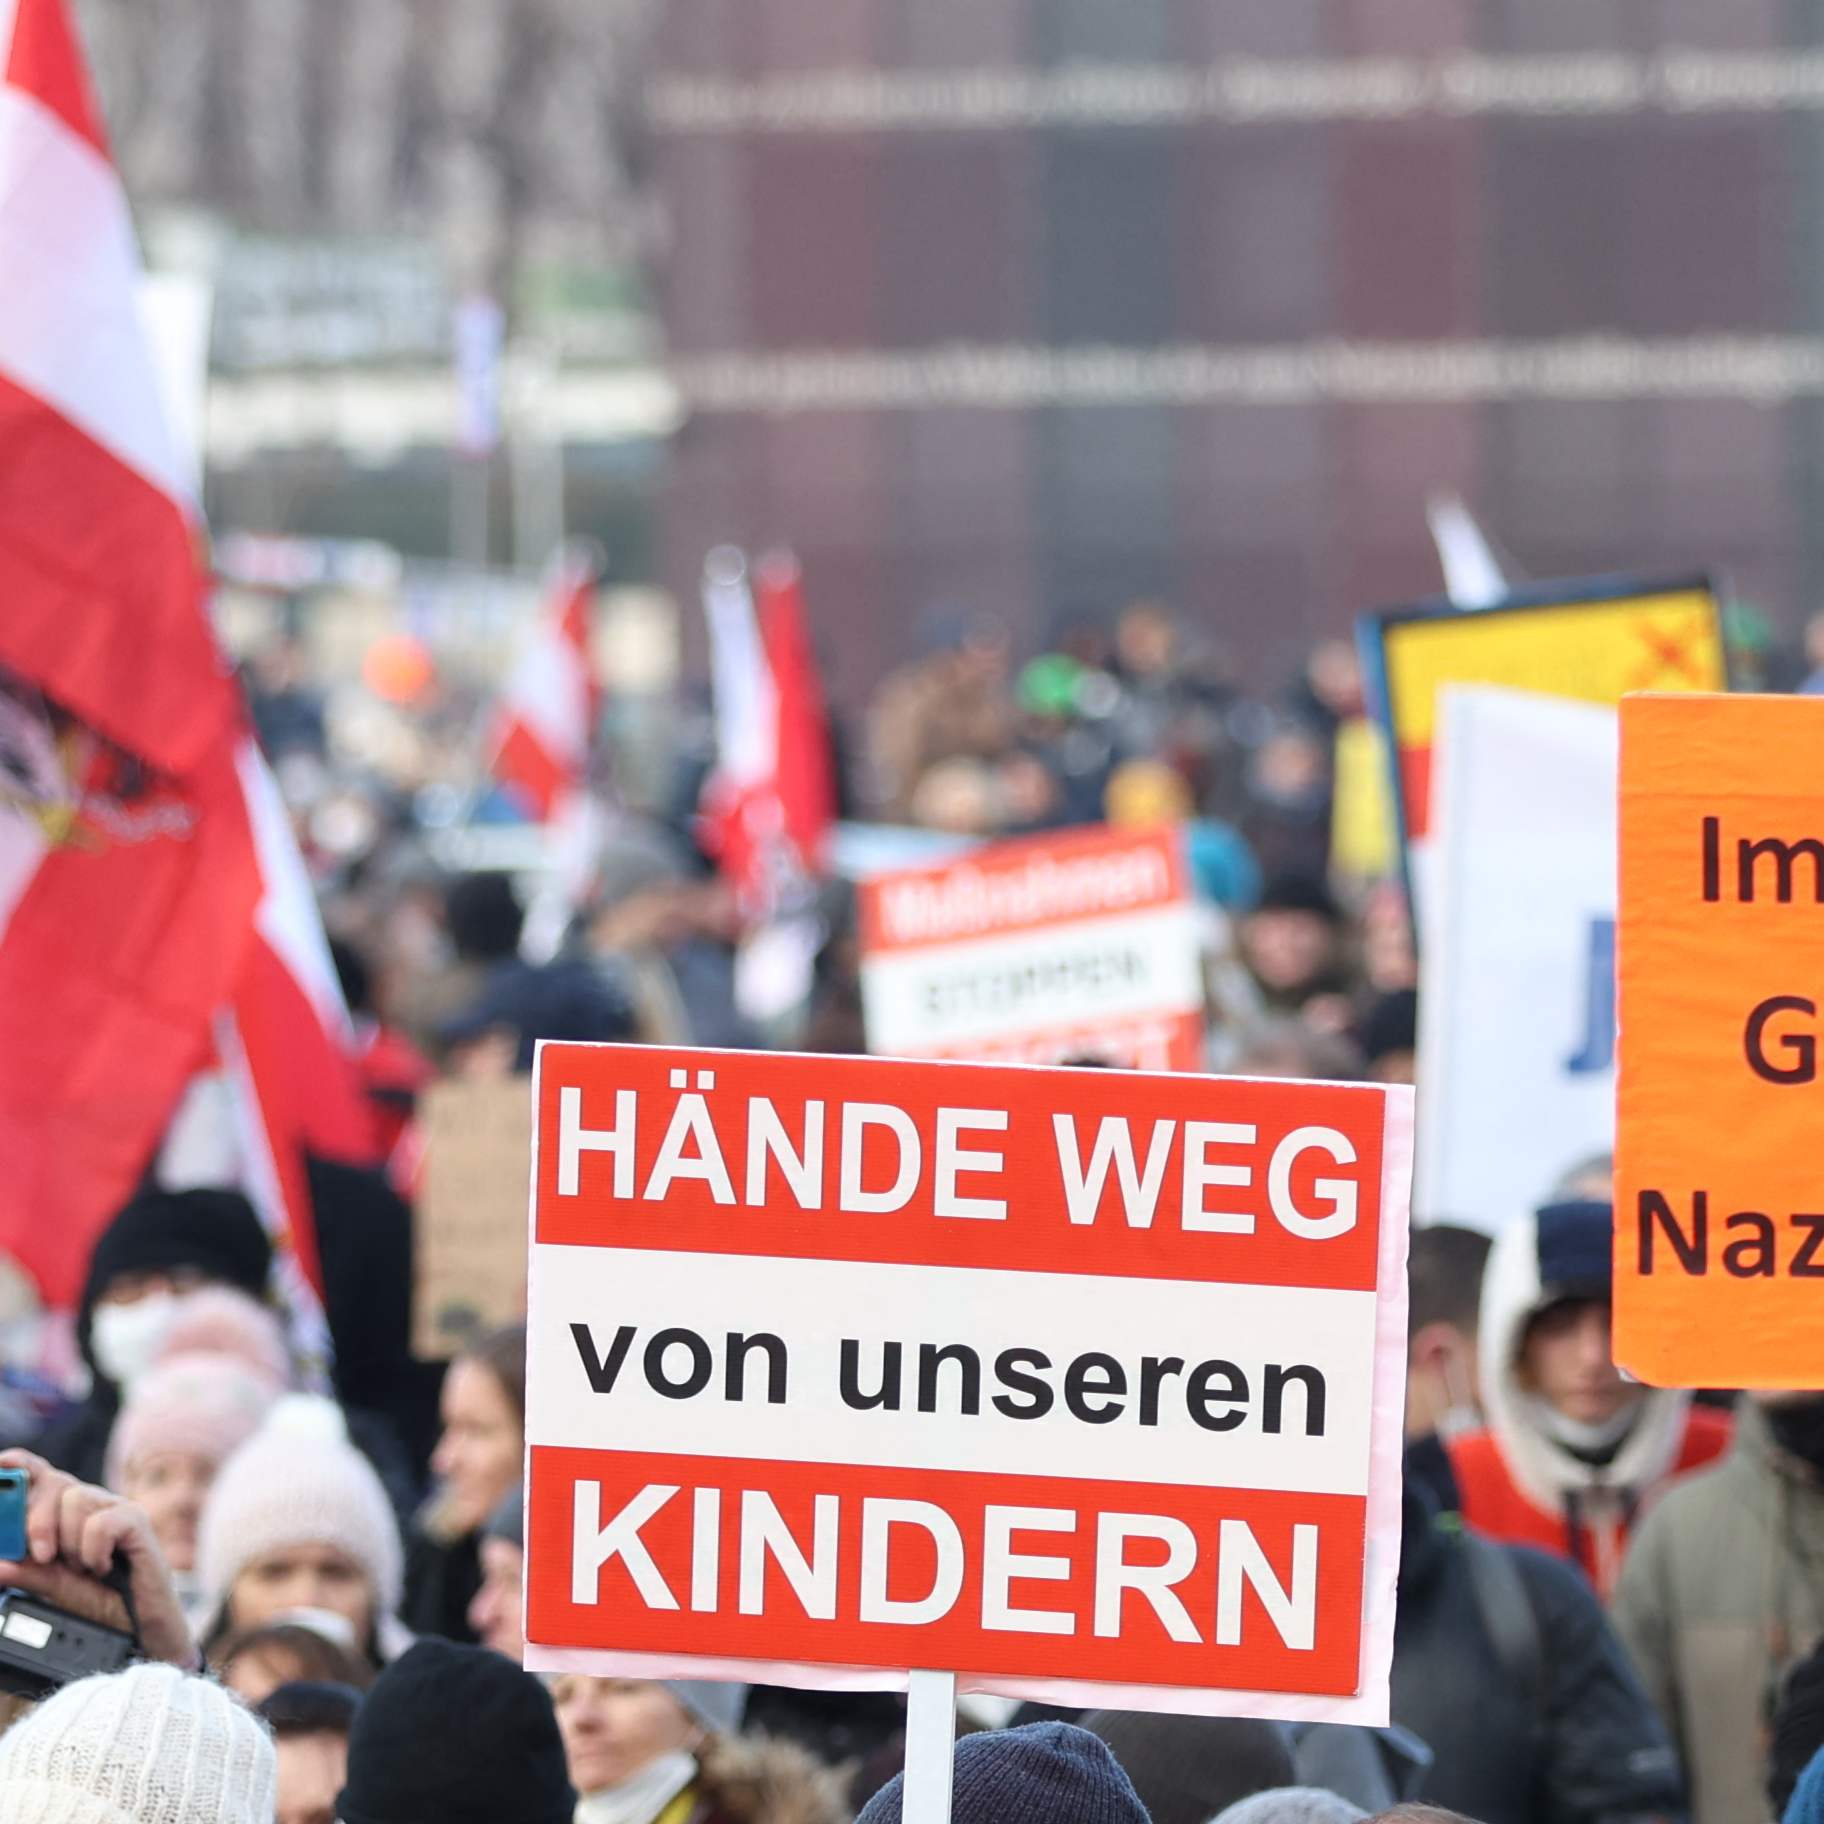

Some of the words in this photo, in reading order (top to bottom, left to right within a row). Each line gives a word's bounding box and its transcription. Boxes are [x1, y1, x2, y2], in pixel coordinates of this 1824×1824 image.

[557, 1069, 1009, 1222] HÄNDE
[1053, 1113, 1359, 1241] WEG
[570, 1322, 788, 1404] von
[840, 1338, 1326, 1438] unseren
[571, 1478, 1319, 1652] KINDERN
